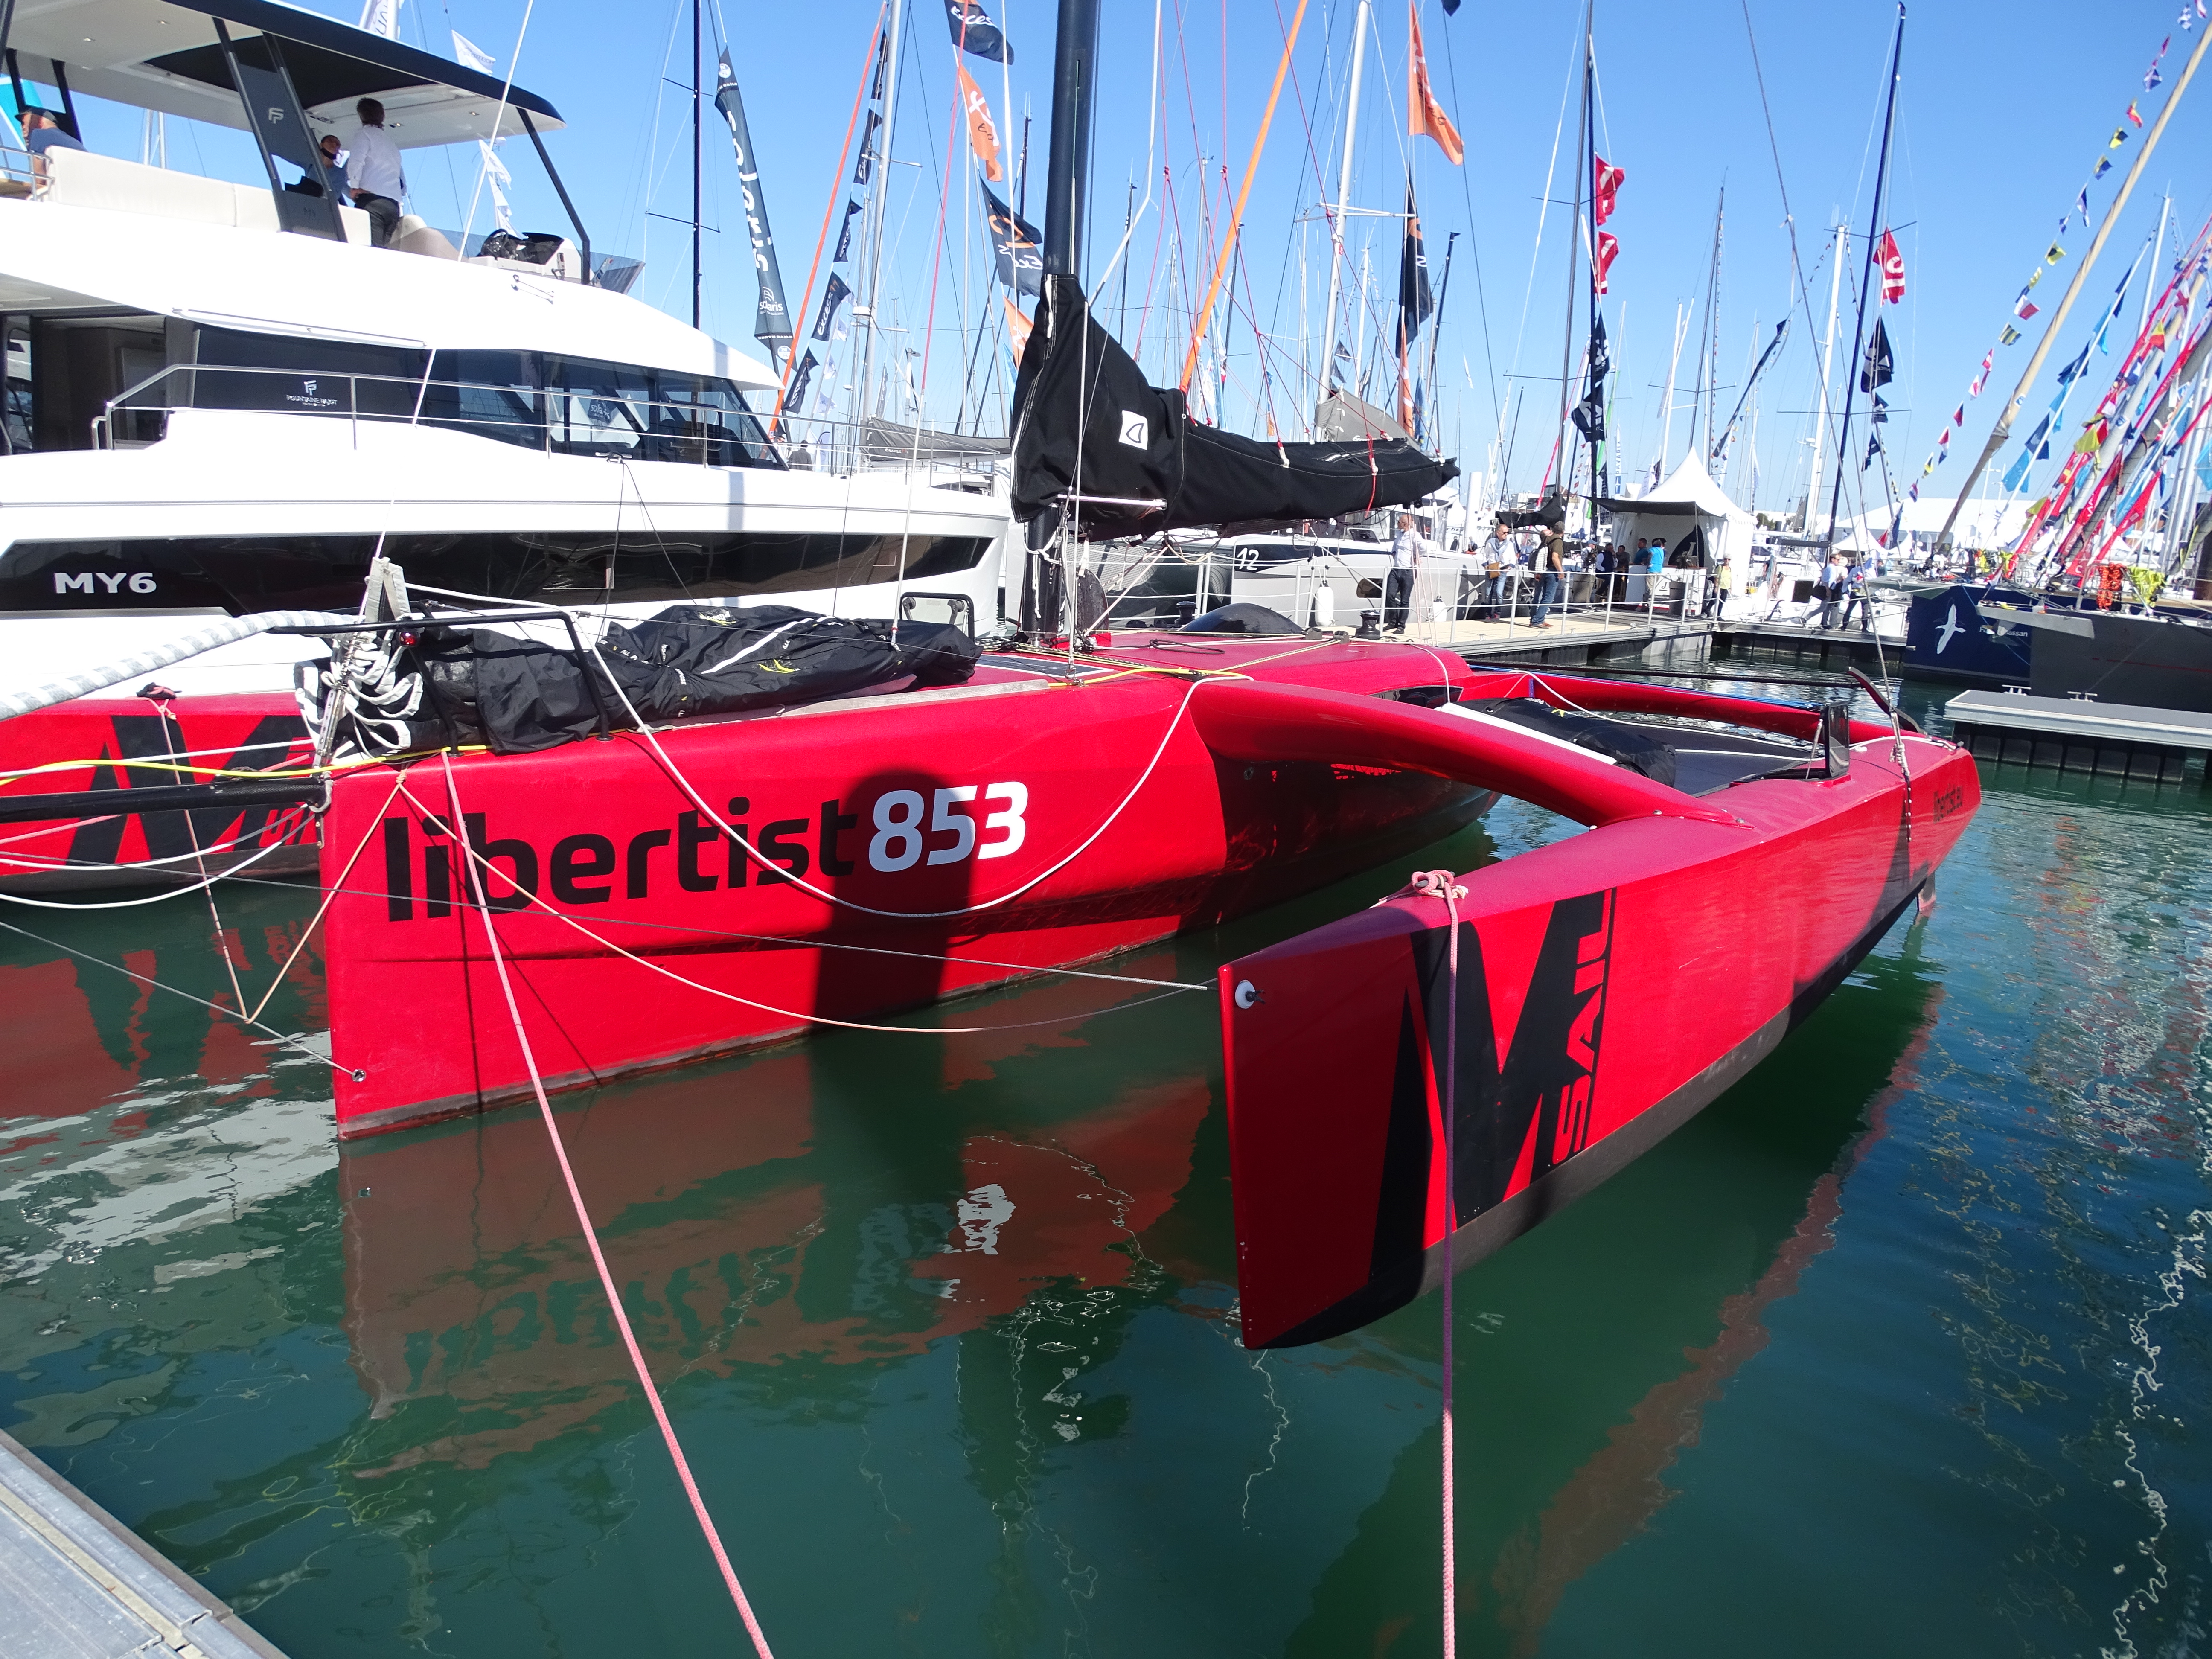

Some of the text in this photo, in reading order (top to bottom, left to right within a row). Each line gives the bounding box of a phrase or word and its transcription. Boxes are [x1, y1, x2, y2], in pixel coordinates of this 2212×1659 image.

[54, 572, 157, 594] MY6
[1237, 547, 1259, 571] 12
[383, 781, 1029, 922] libertist 853
[1552, 888, 1613, 1164] SAIL
